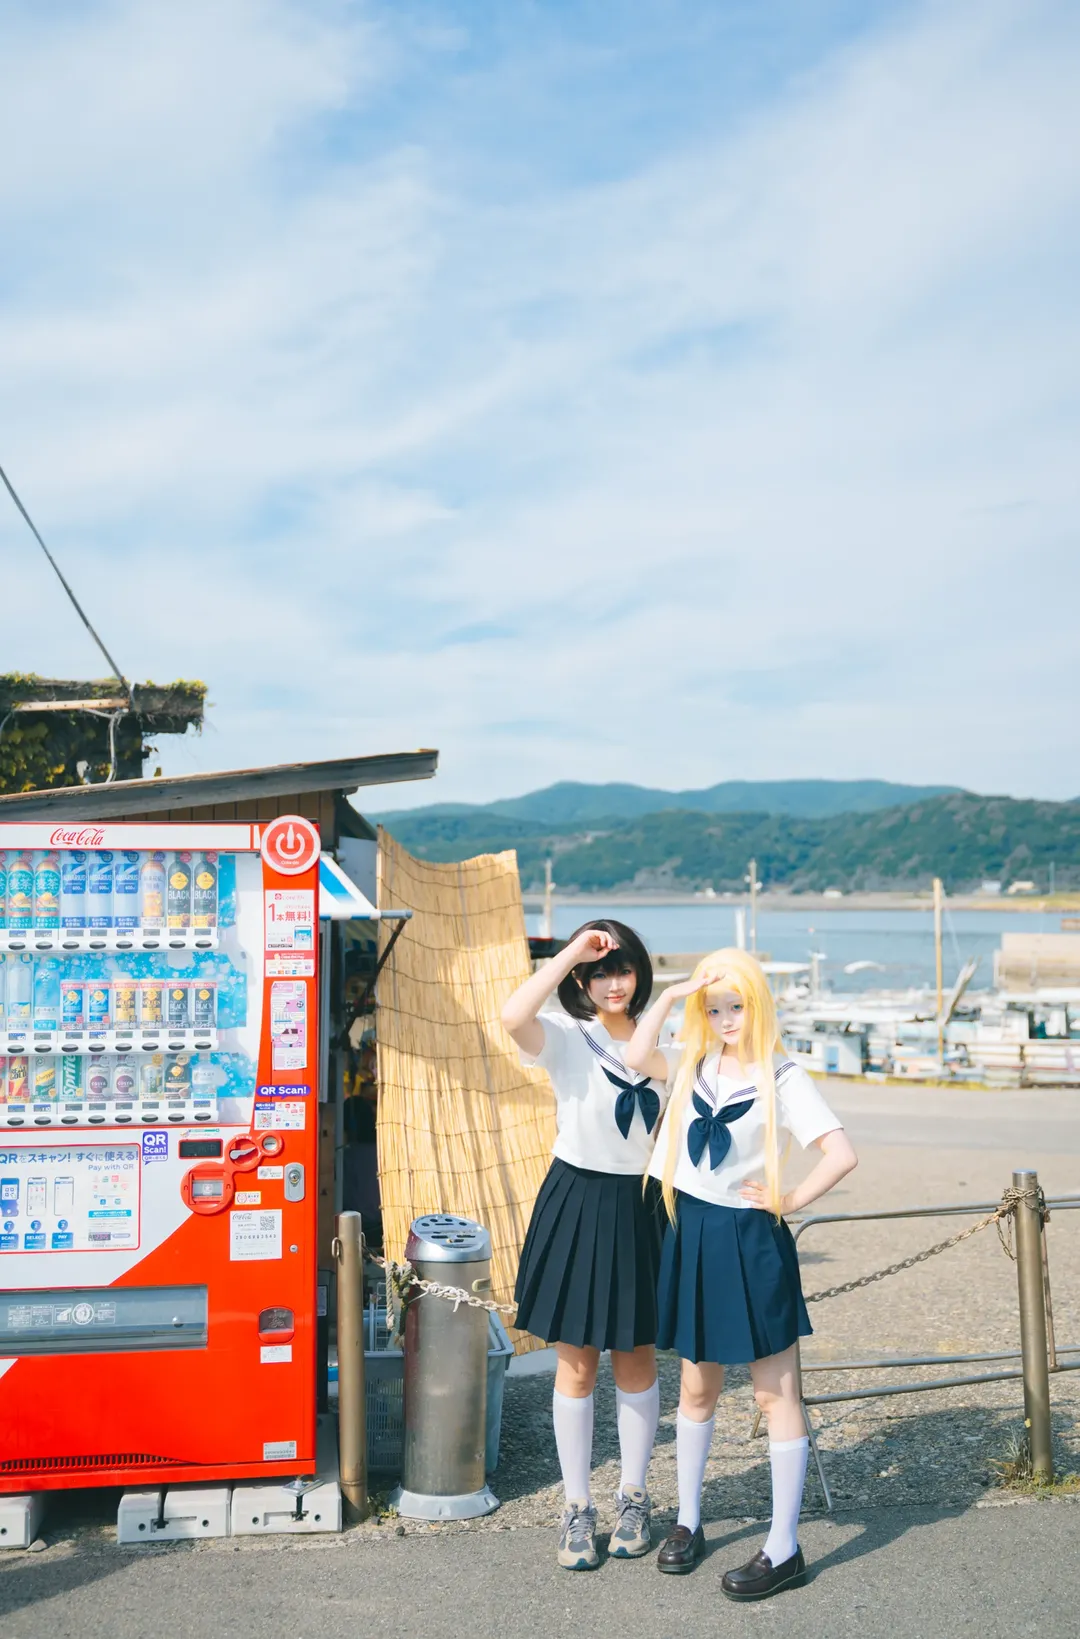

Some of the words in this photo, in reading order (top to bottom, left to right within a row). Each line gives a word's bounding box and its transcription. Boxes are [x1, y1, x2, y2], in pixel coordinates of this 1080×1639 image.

[50, 827, 106, 847] Coca-Cola
[168, 890, 190, 899] BLACK
[195, 890, 217, 899] BLACK
[64, 1055, 77, 1096] Sprite
[261, 1086, 276, 1095] QR
[278, 1085, 307, 1095] Scan!
[143, 1134, 166, 1145] QR
[144, 1146, 167, 1154] Scan!
[0, 1152, 71, 1165] QRをスキャン!
[76, 1151, 139, 1162] すぐに使える!
